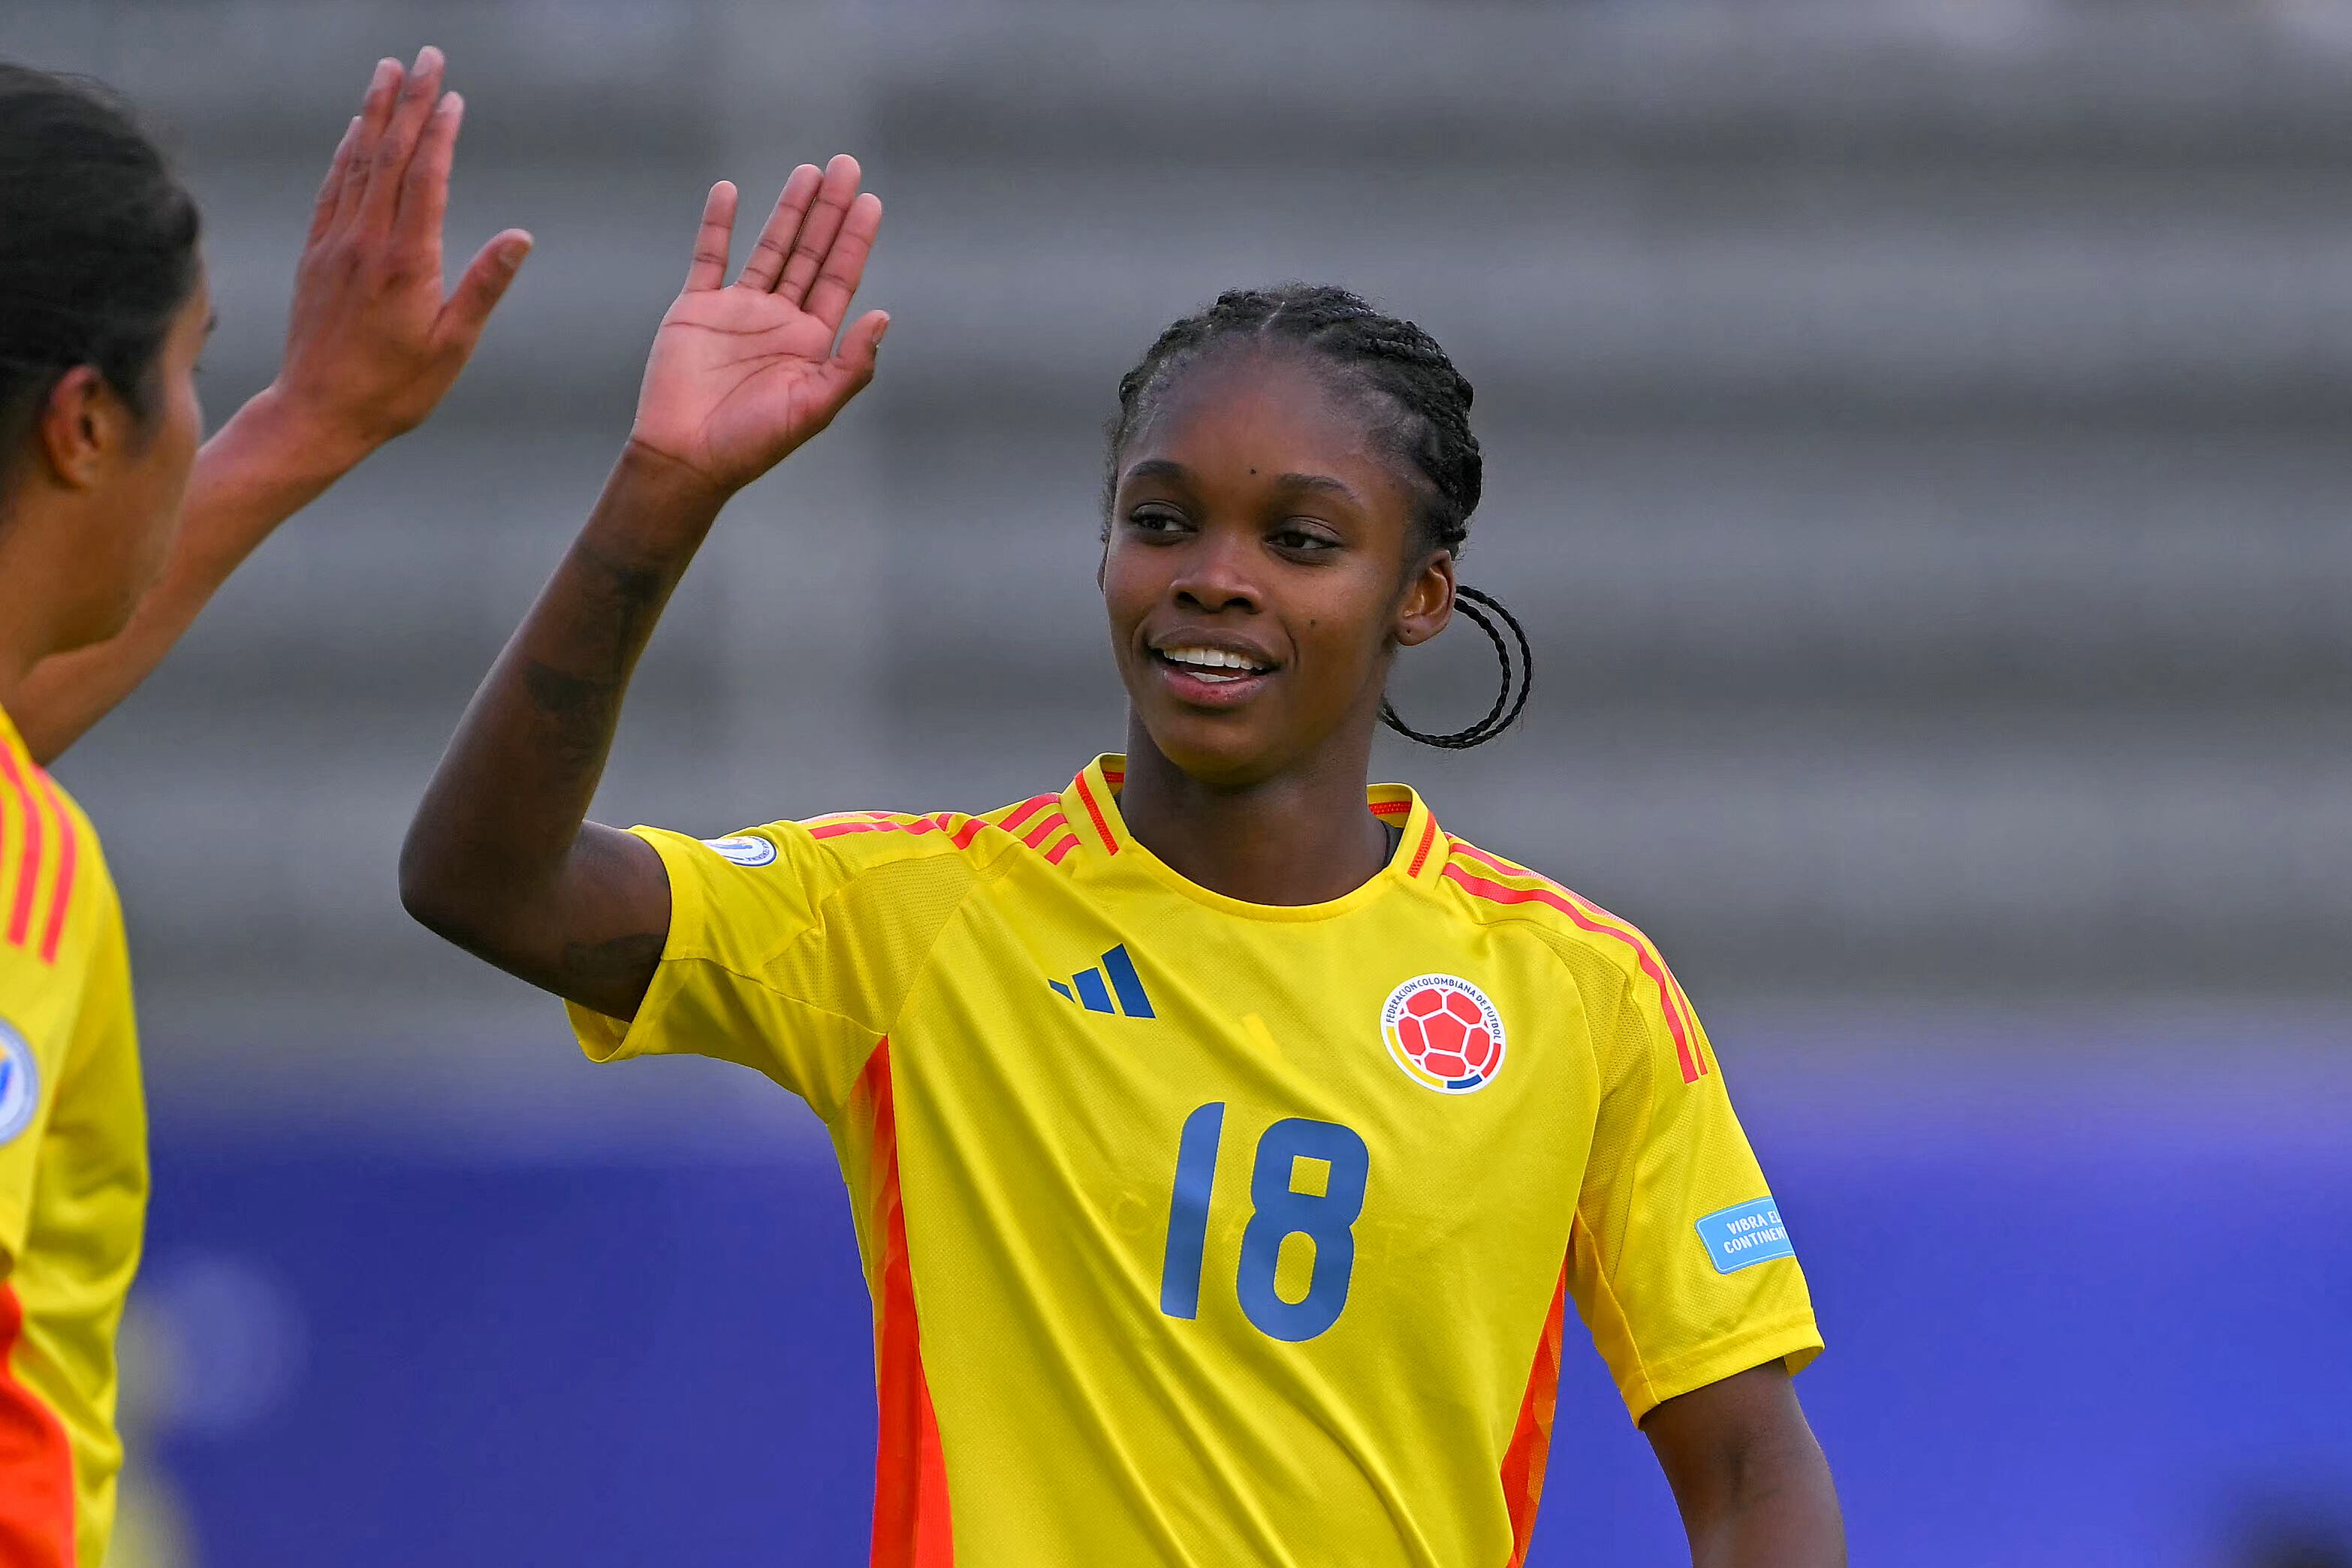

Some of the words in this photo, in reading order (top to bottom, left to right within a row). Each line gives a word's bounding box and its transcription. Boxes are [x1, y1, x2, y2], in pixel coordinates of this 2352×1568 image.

[1417, 977, 1476, 997] COLOMBIANA
[1476, 994, 1487, 1006] DE
[1484, 1006, 1501, 1039] FÚTBOL
[1159, 1101, 1370, 1343] 18
[1726, 1213, 1768, 1235] VIBRA
